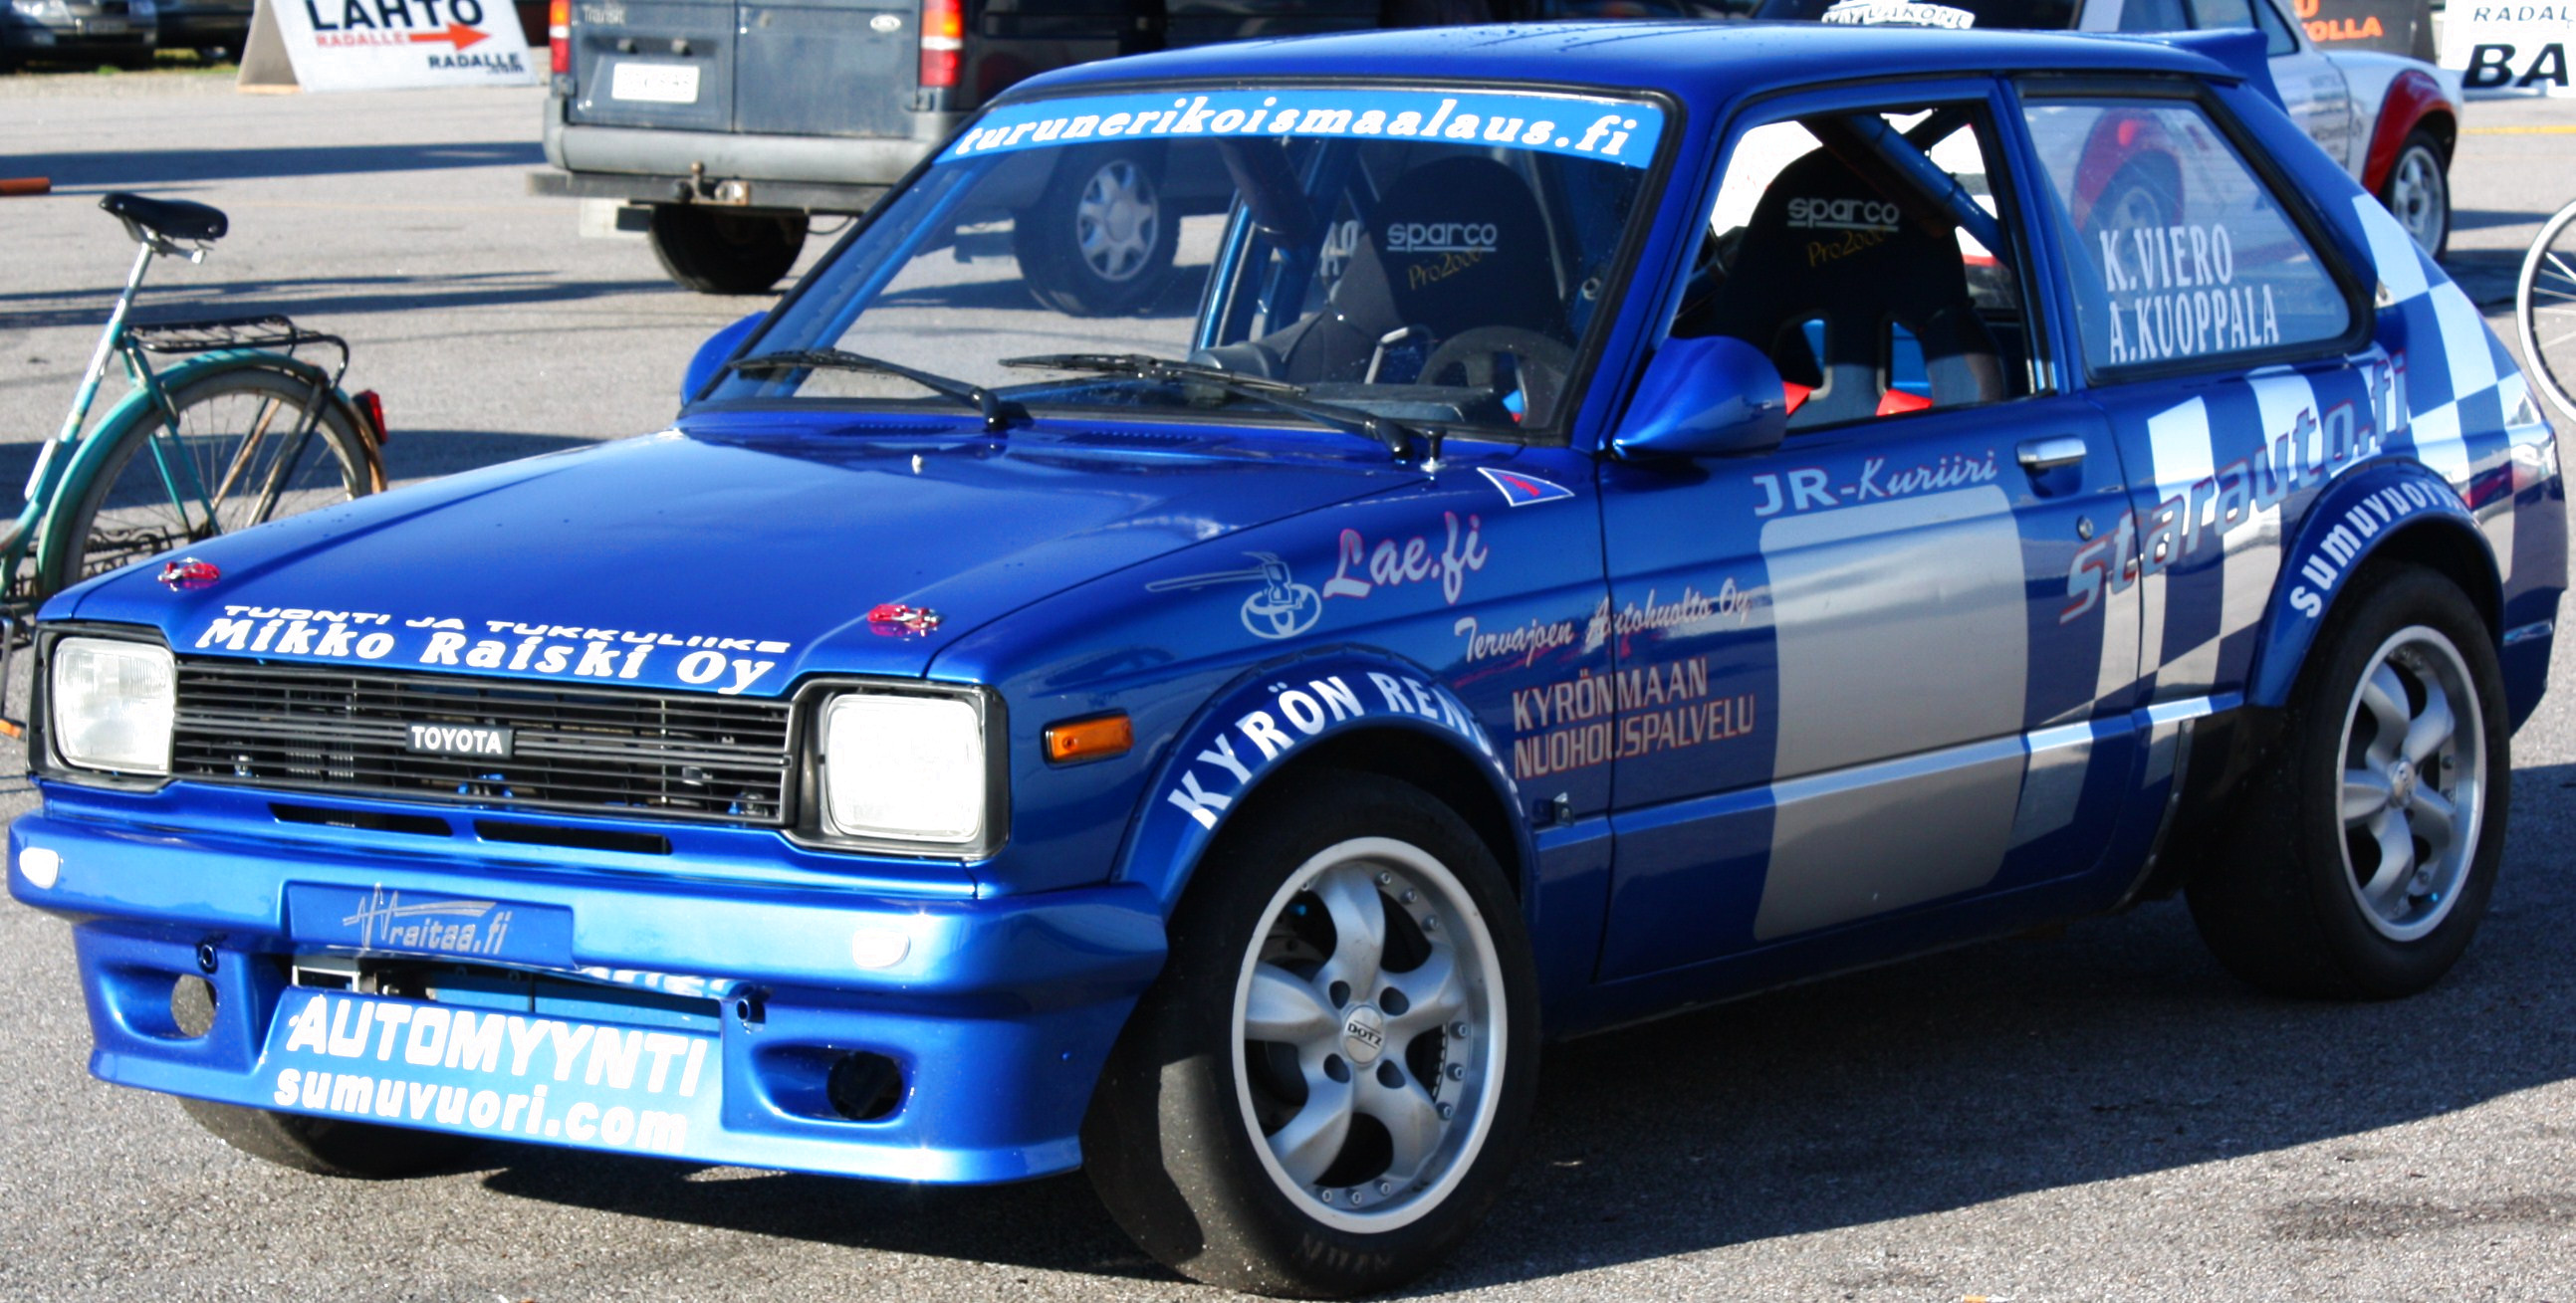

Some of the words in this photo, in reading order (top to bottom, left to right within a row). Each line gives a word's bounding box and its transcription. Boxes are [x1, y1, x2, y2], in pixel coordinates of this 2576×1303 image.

[316, 31, 402, 47] RADALLE
[427, 53, 521, 69] RADALLE
[2460, 43, 2569, 88] BA
[955, 97, 1638, 155] turunerikoismaalaus.fi
[1387, 222, 1498, 251] sparco
[1785, 197, 1900, 230] sparco
[2099, 223, 2233, 293] K.VIERO
[2109, 284, 2280, 364] A.KUOPPALA
[224, 604, 391, 627] TUONTI
[405, 617, 465, 631] JA
[486, 620, 791, 654] TUKKULIIKE
[1453, 616, 1573, 668] Tervajoen
[1717, 575, 1753, 627] Oy
[194, 616, 395, 660] Mikko
[419, 630, 657, 680] Raiski
[676, 649, 777, 695] Oy
[1512, 656, 1709, 733] KYRÖNMAAN
[410, 725, 504, 755] TOYOTA
[1167, 676, 1365, 830] KYRÖN
[1513, 695, 1756, 780] NUOHOUSPALVELU
[285, 992, 709, 1098] AUTOMYYNTI
[1347, 1021, 1382, 1046] DOTZ
[273, 1066, 689, 1153] sumuvuori.com
